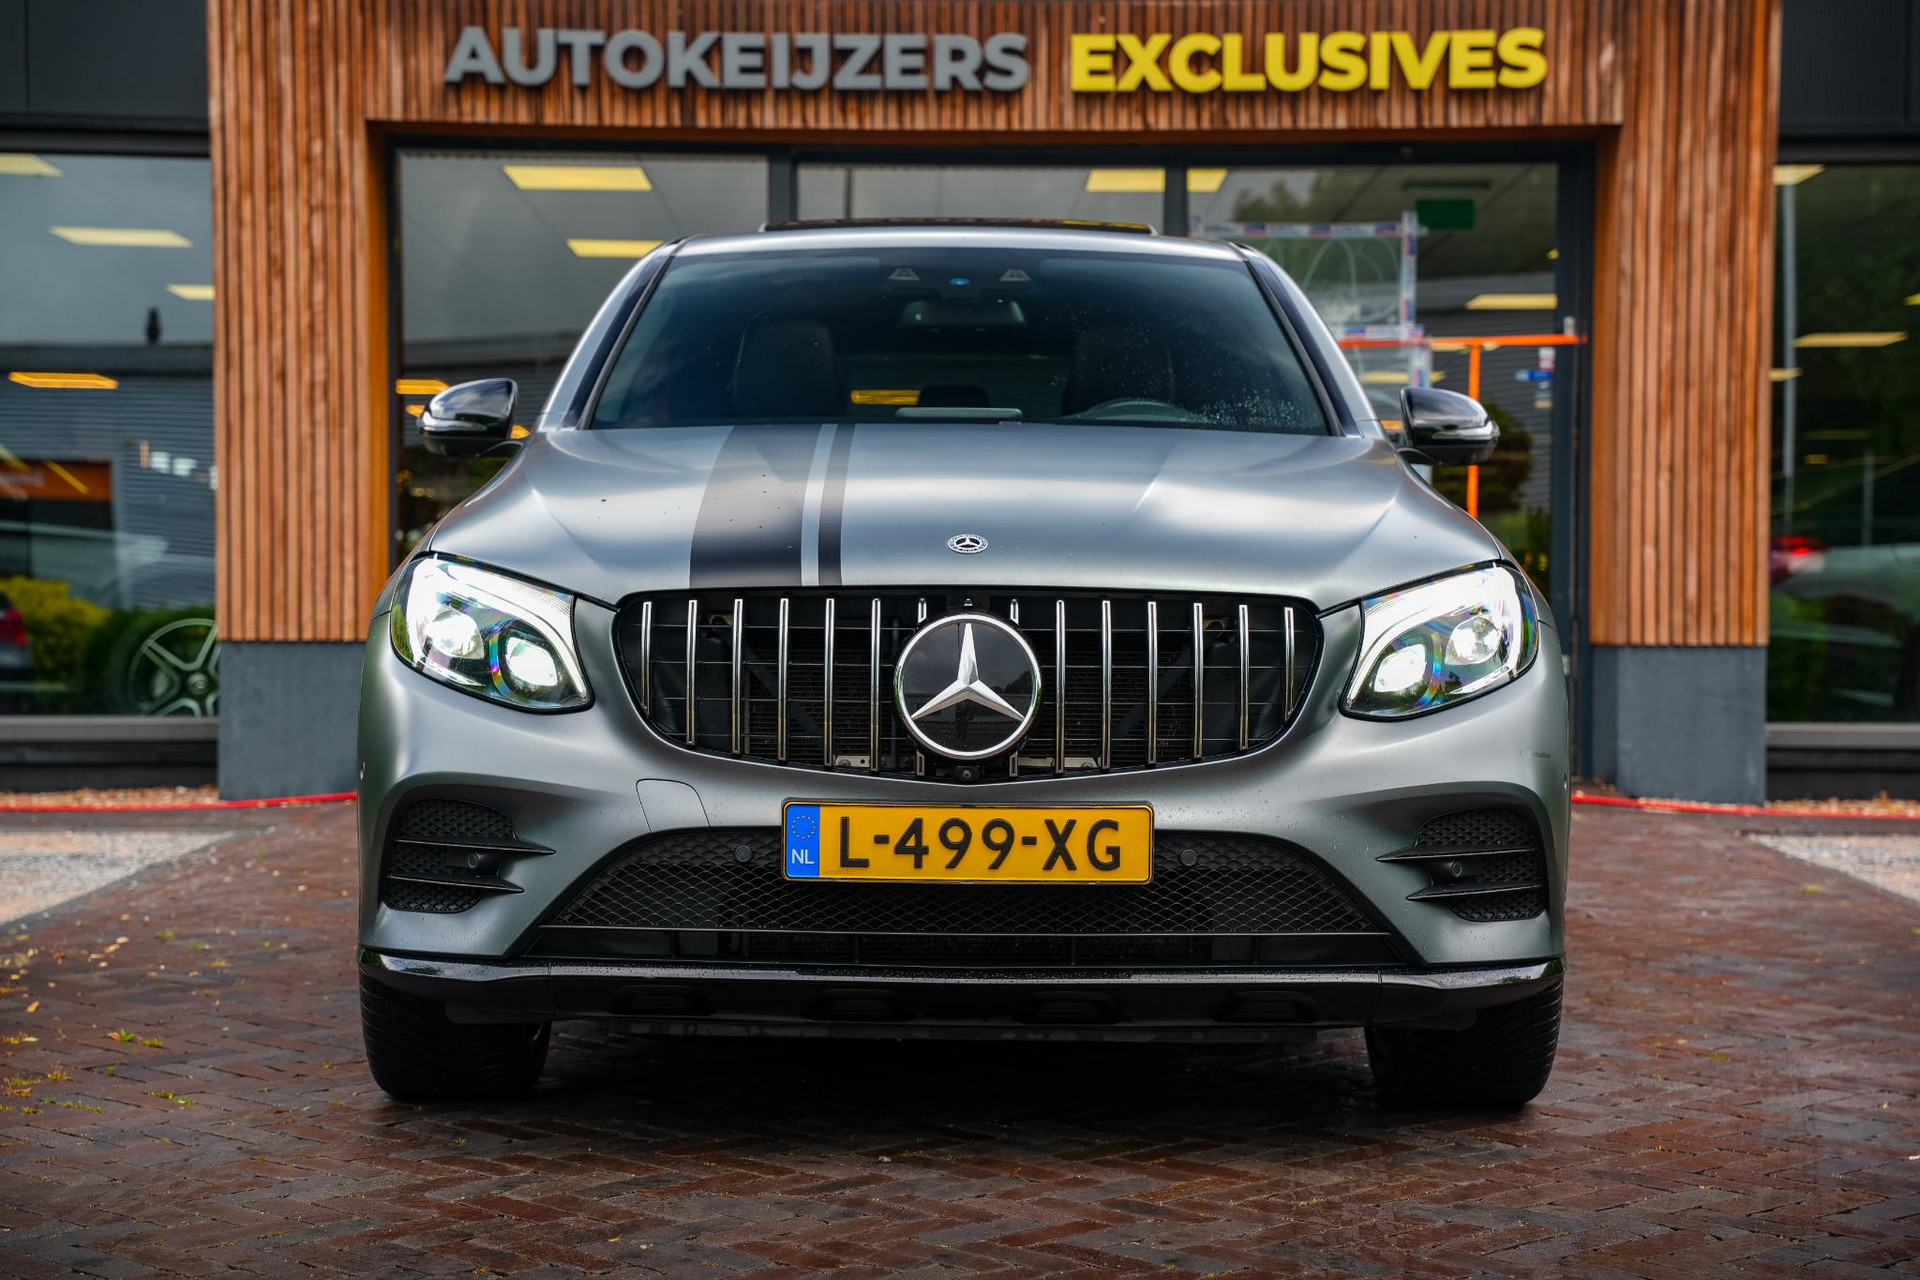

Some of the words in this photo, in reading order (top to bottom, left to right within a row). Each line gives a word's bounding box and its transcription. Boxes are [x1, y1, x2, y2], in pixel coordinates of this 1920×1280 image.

[444, 26, 1030, 91] AUTOKEIJZERS
[1071, 28, 1548, 92] EXCLUSIVES
[791, 849, 814, 865] NL
[840, 816, 1121, 871] L-499-XG
